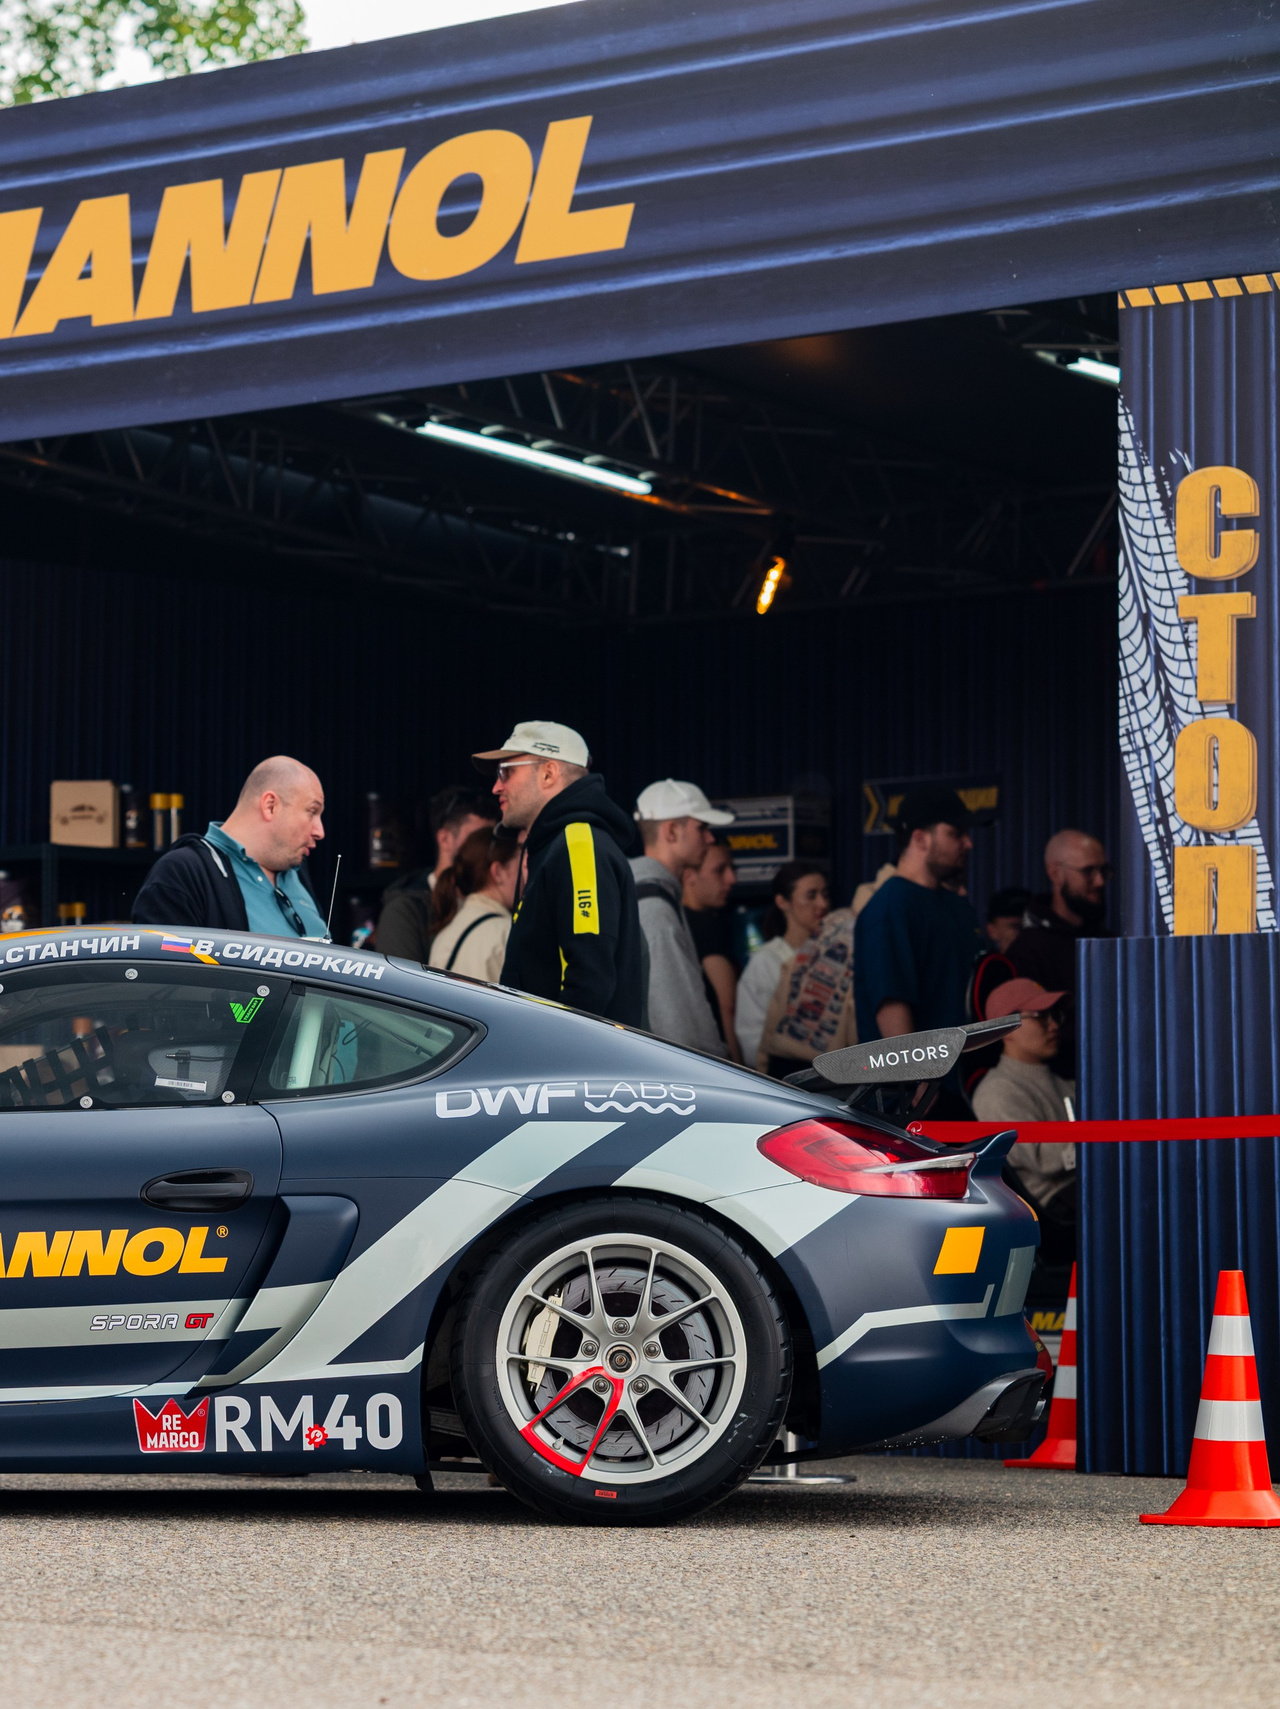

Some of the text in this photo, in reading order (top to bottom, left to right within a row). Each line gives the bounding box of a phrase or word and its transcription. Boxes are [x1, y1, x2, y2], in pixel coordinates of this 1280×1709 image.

[1173, 465, 1260, 937] СТОП
[578, 889, 591, 918] #911
[194, 940, 386, 980] В.СИДОРКИН
[436, 1082, 696, 1118] DWF LABS
[89, 1313, 214, 1331] SPORA GT
[530, 1299, 557, 1380] PRSCH
[162, 1414, 181, 1431] RE
[147, 1431, 199, 1449] MARCO
